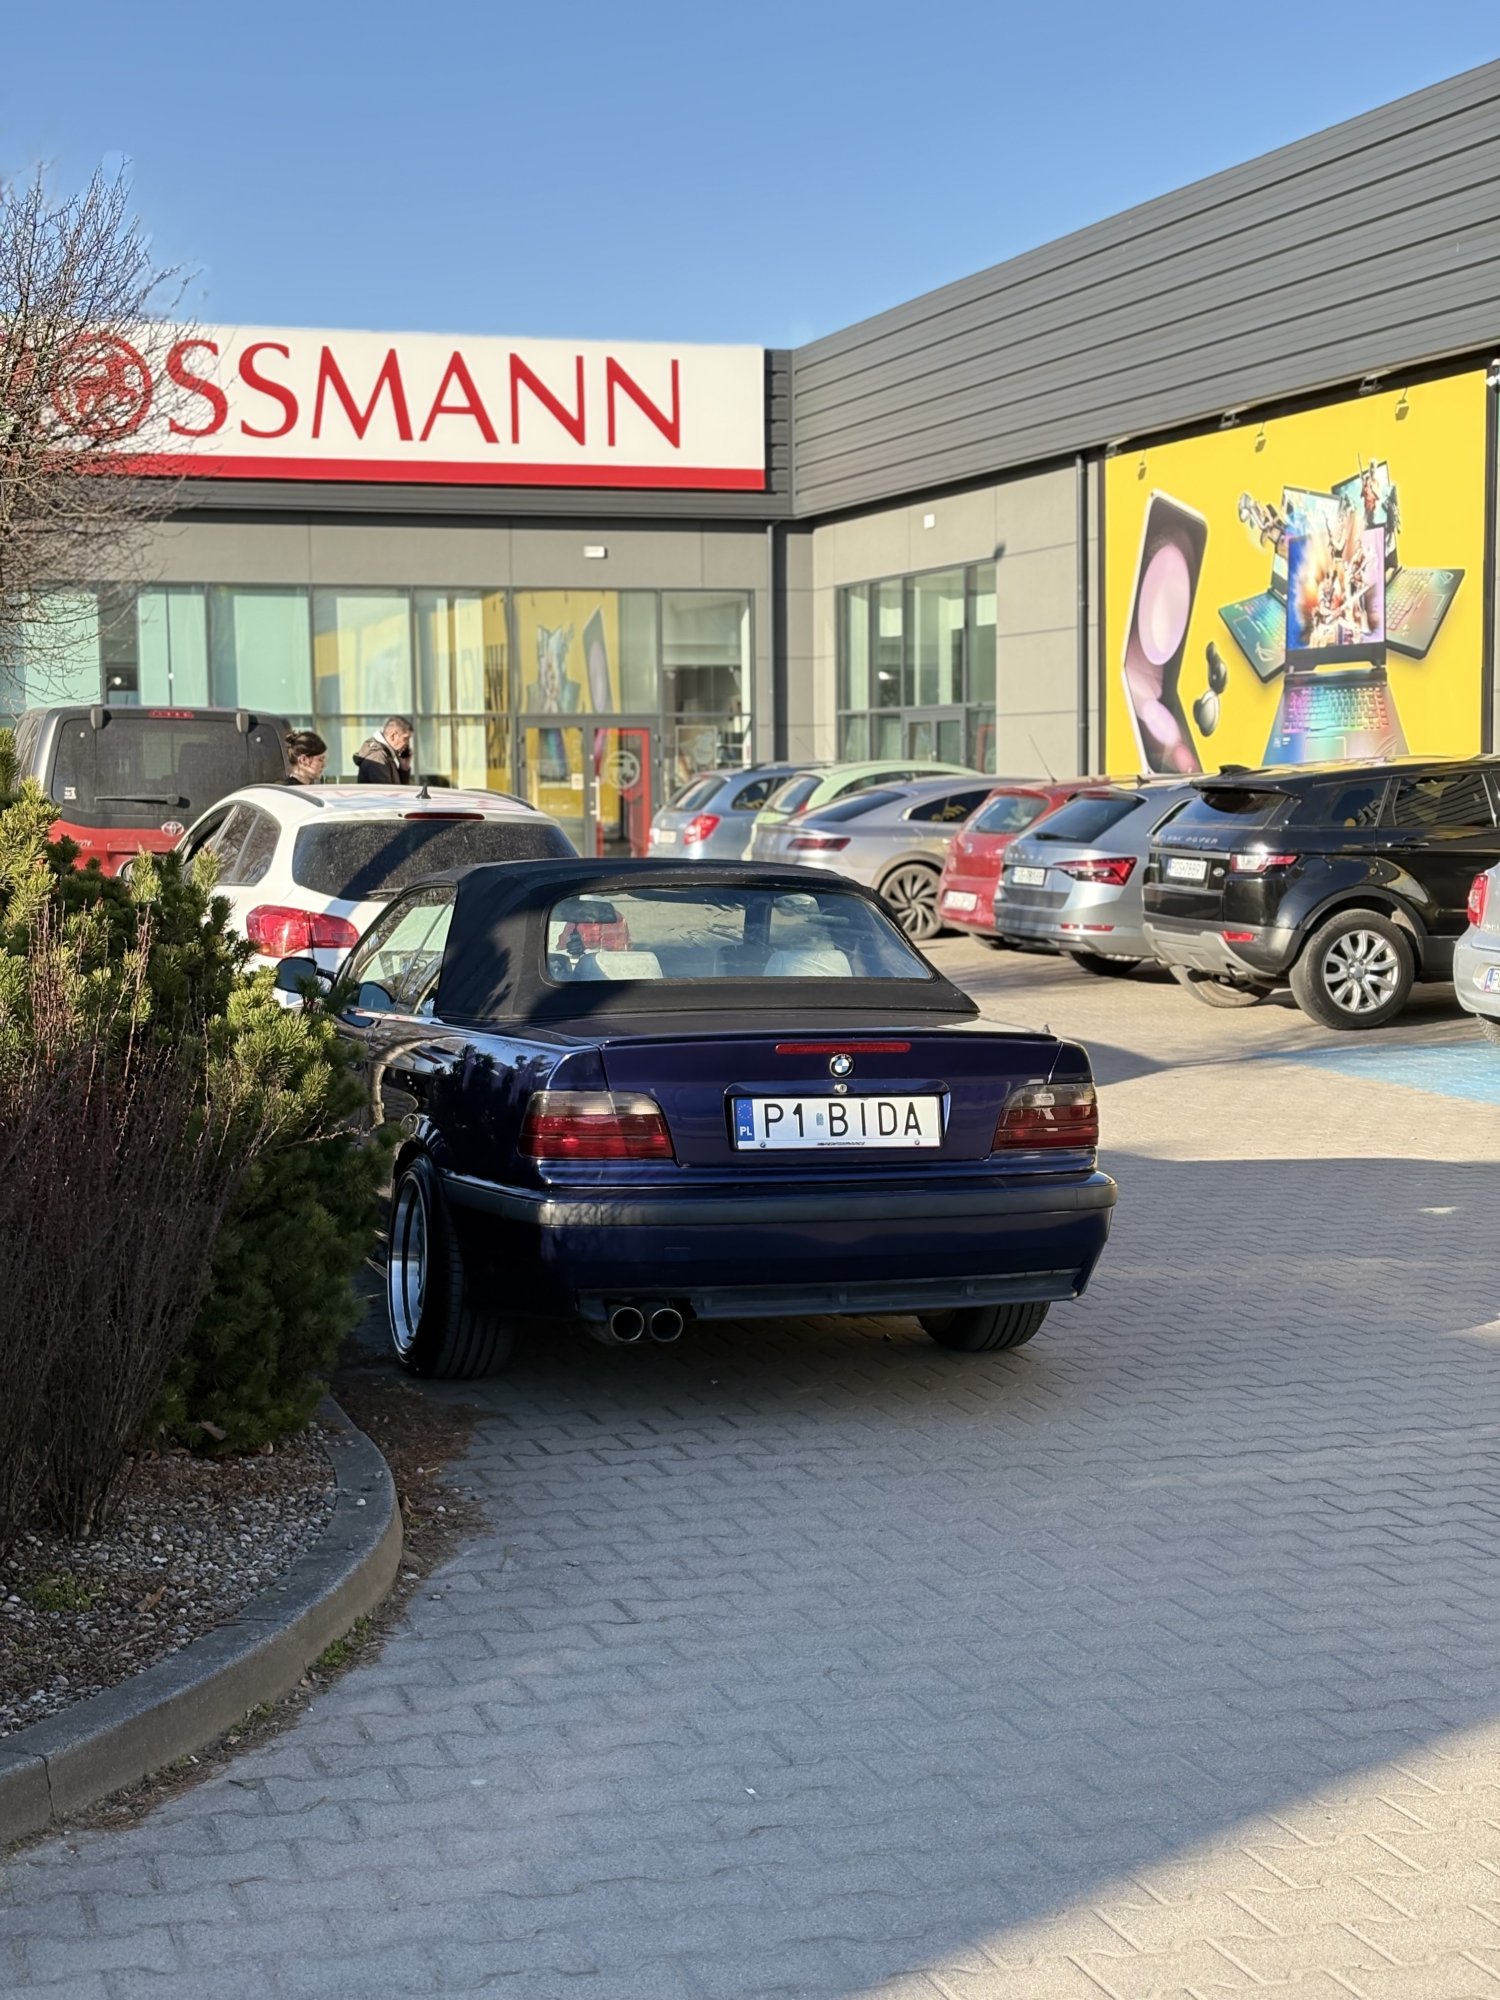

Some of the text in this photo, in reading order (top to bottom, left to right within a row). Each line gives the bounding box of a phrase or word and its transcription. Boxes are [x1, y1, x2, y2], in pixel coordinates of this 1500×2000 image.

[740, 1126, 752, 1136] PL
[764, 1102, 922, 1138] P1 BIDA
